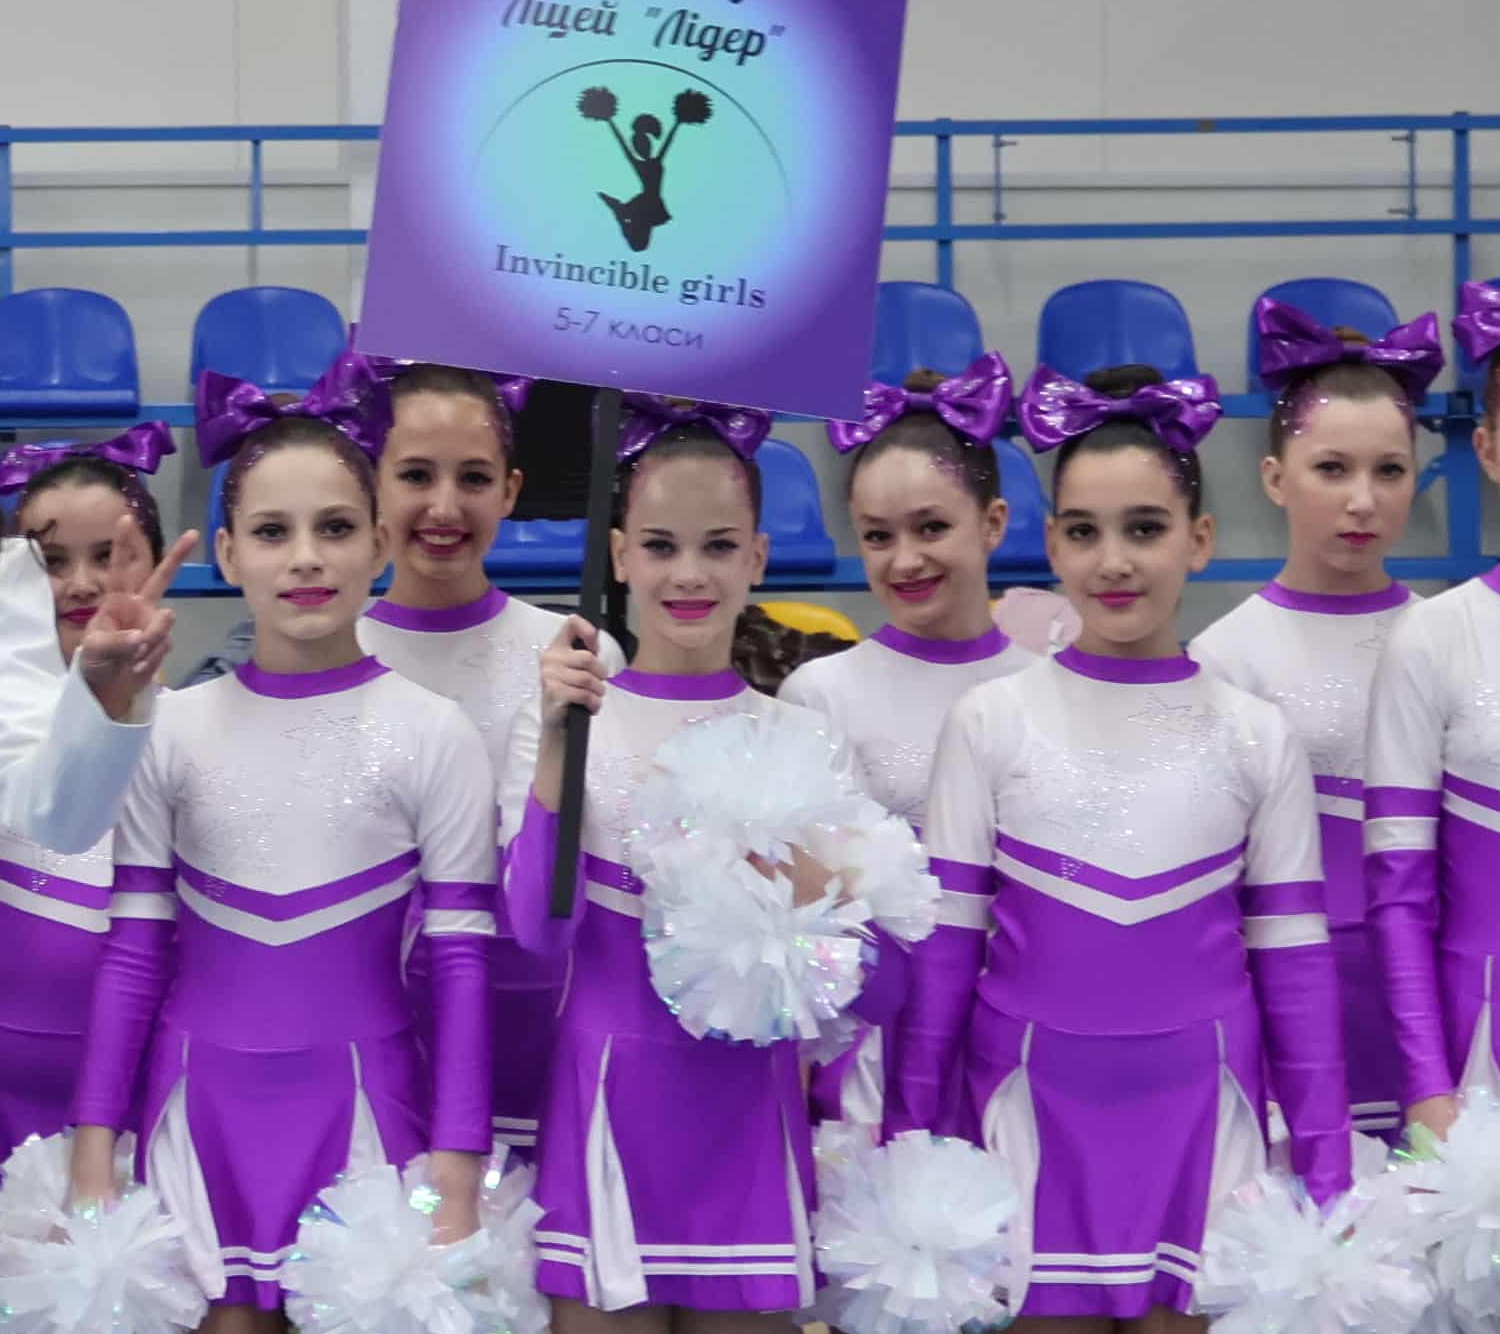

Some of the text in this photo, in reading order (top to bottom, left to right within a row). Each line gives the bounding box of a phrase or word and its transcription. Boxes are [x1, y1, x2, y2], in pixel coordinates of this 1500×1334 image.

[645, 6, 787, 66] "Лідер"
[495, 244, 767, 310] Invincible girls
[553, 307, 705, 349] 5-7 класи
